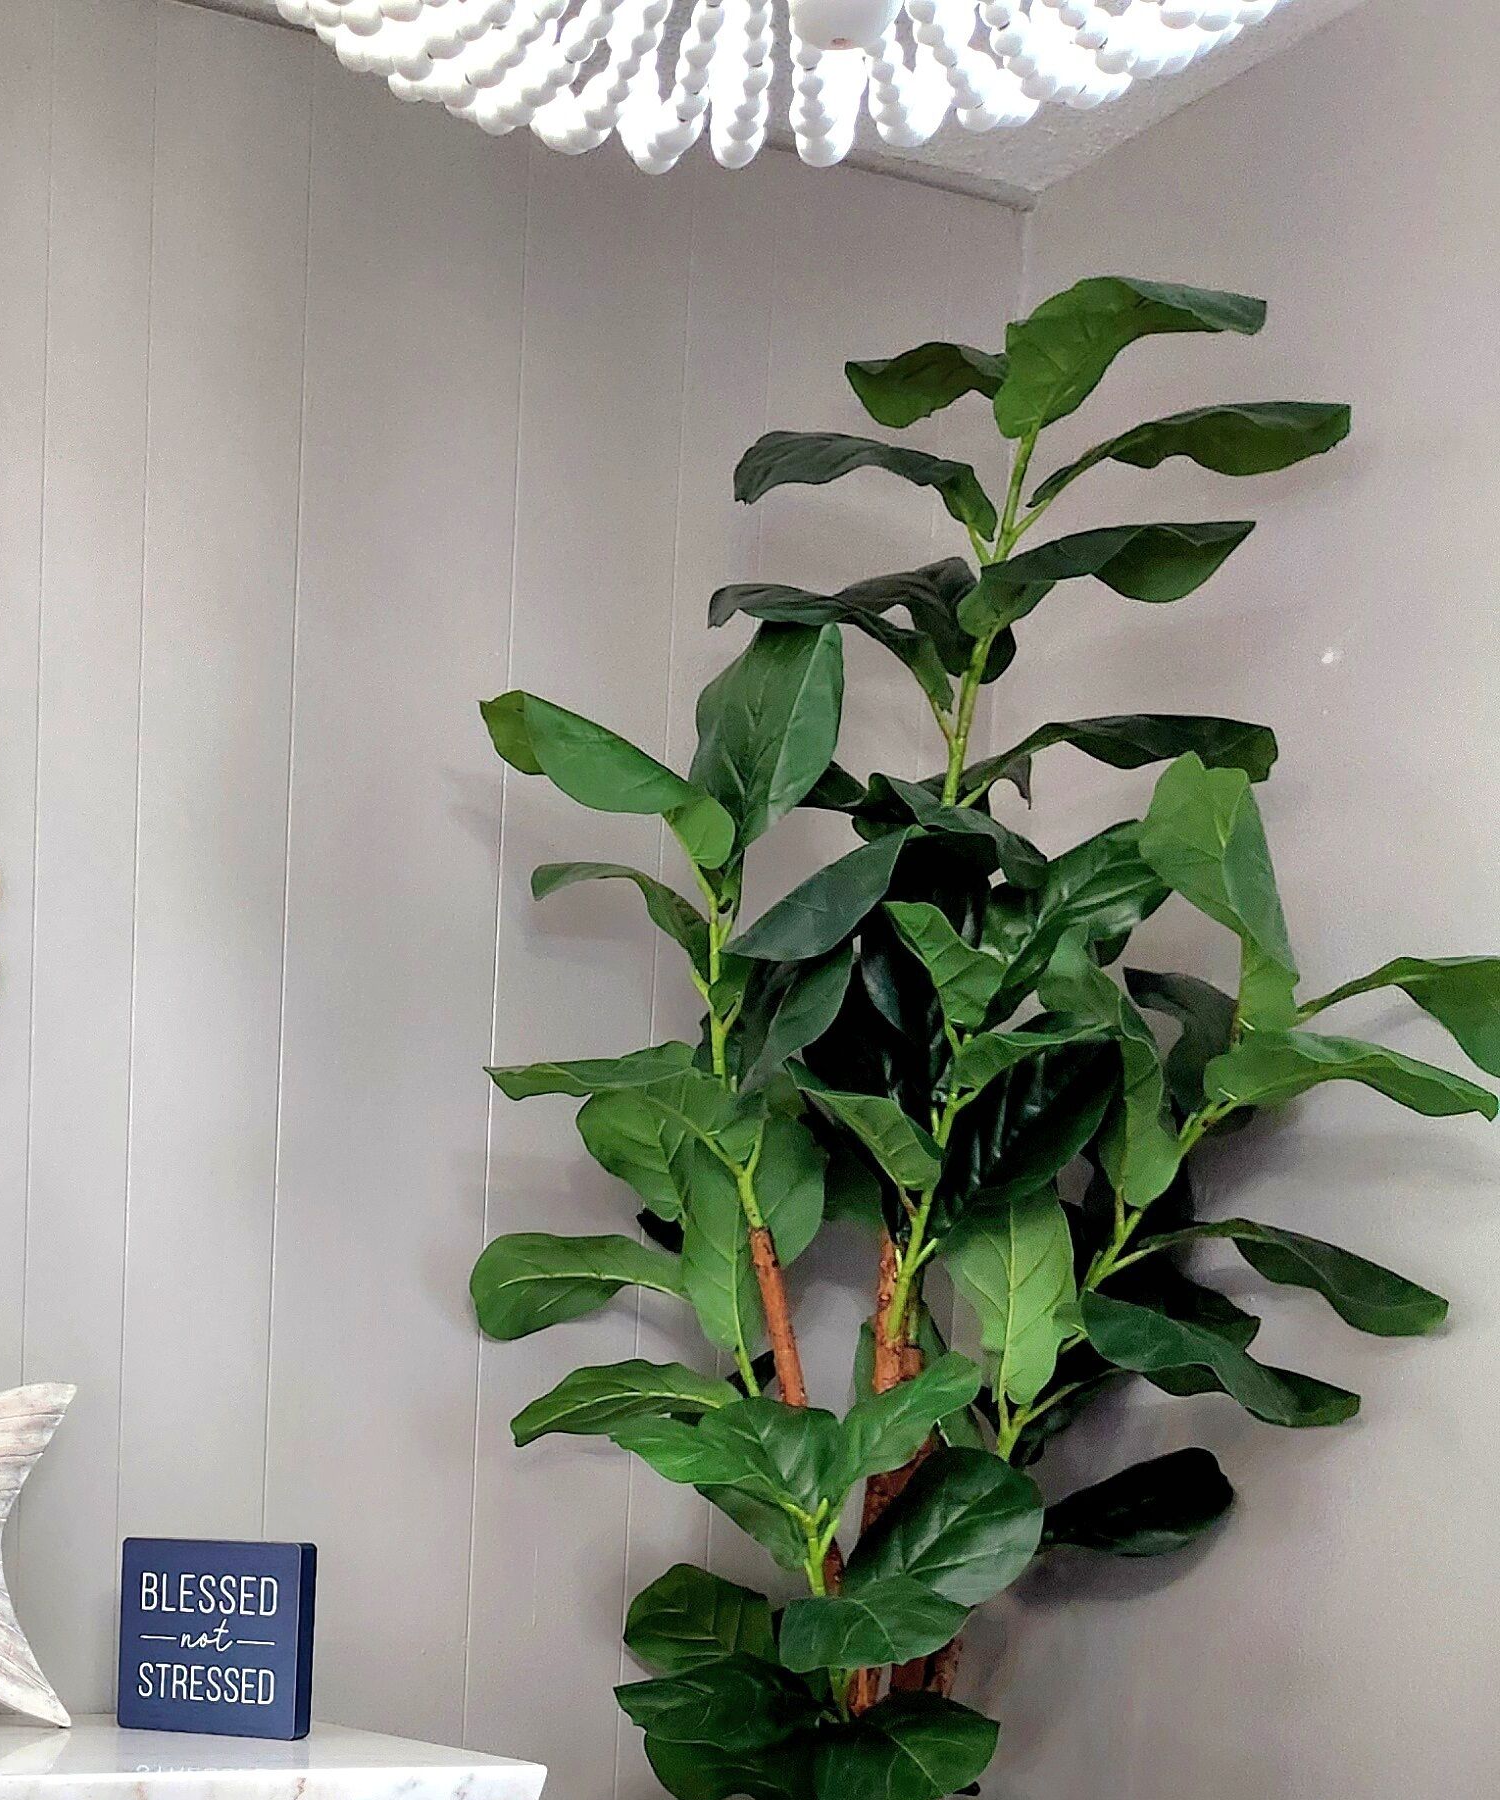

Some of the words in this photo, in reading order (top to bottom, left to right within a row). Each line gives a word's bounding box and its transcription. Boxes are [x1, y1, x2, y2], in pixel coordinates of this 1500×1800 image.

[141, 1572, 278, 1616] BLESSED
[180, 1618, 233, 1652] not
[138, 1662, 275, 1705] STRESSED
